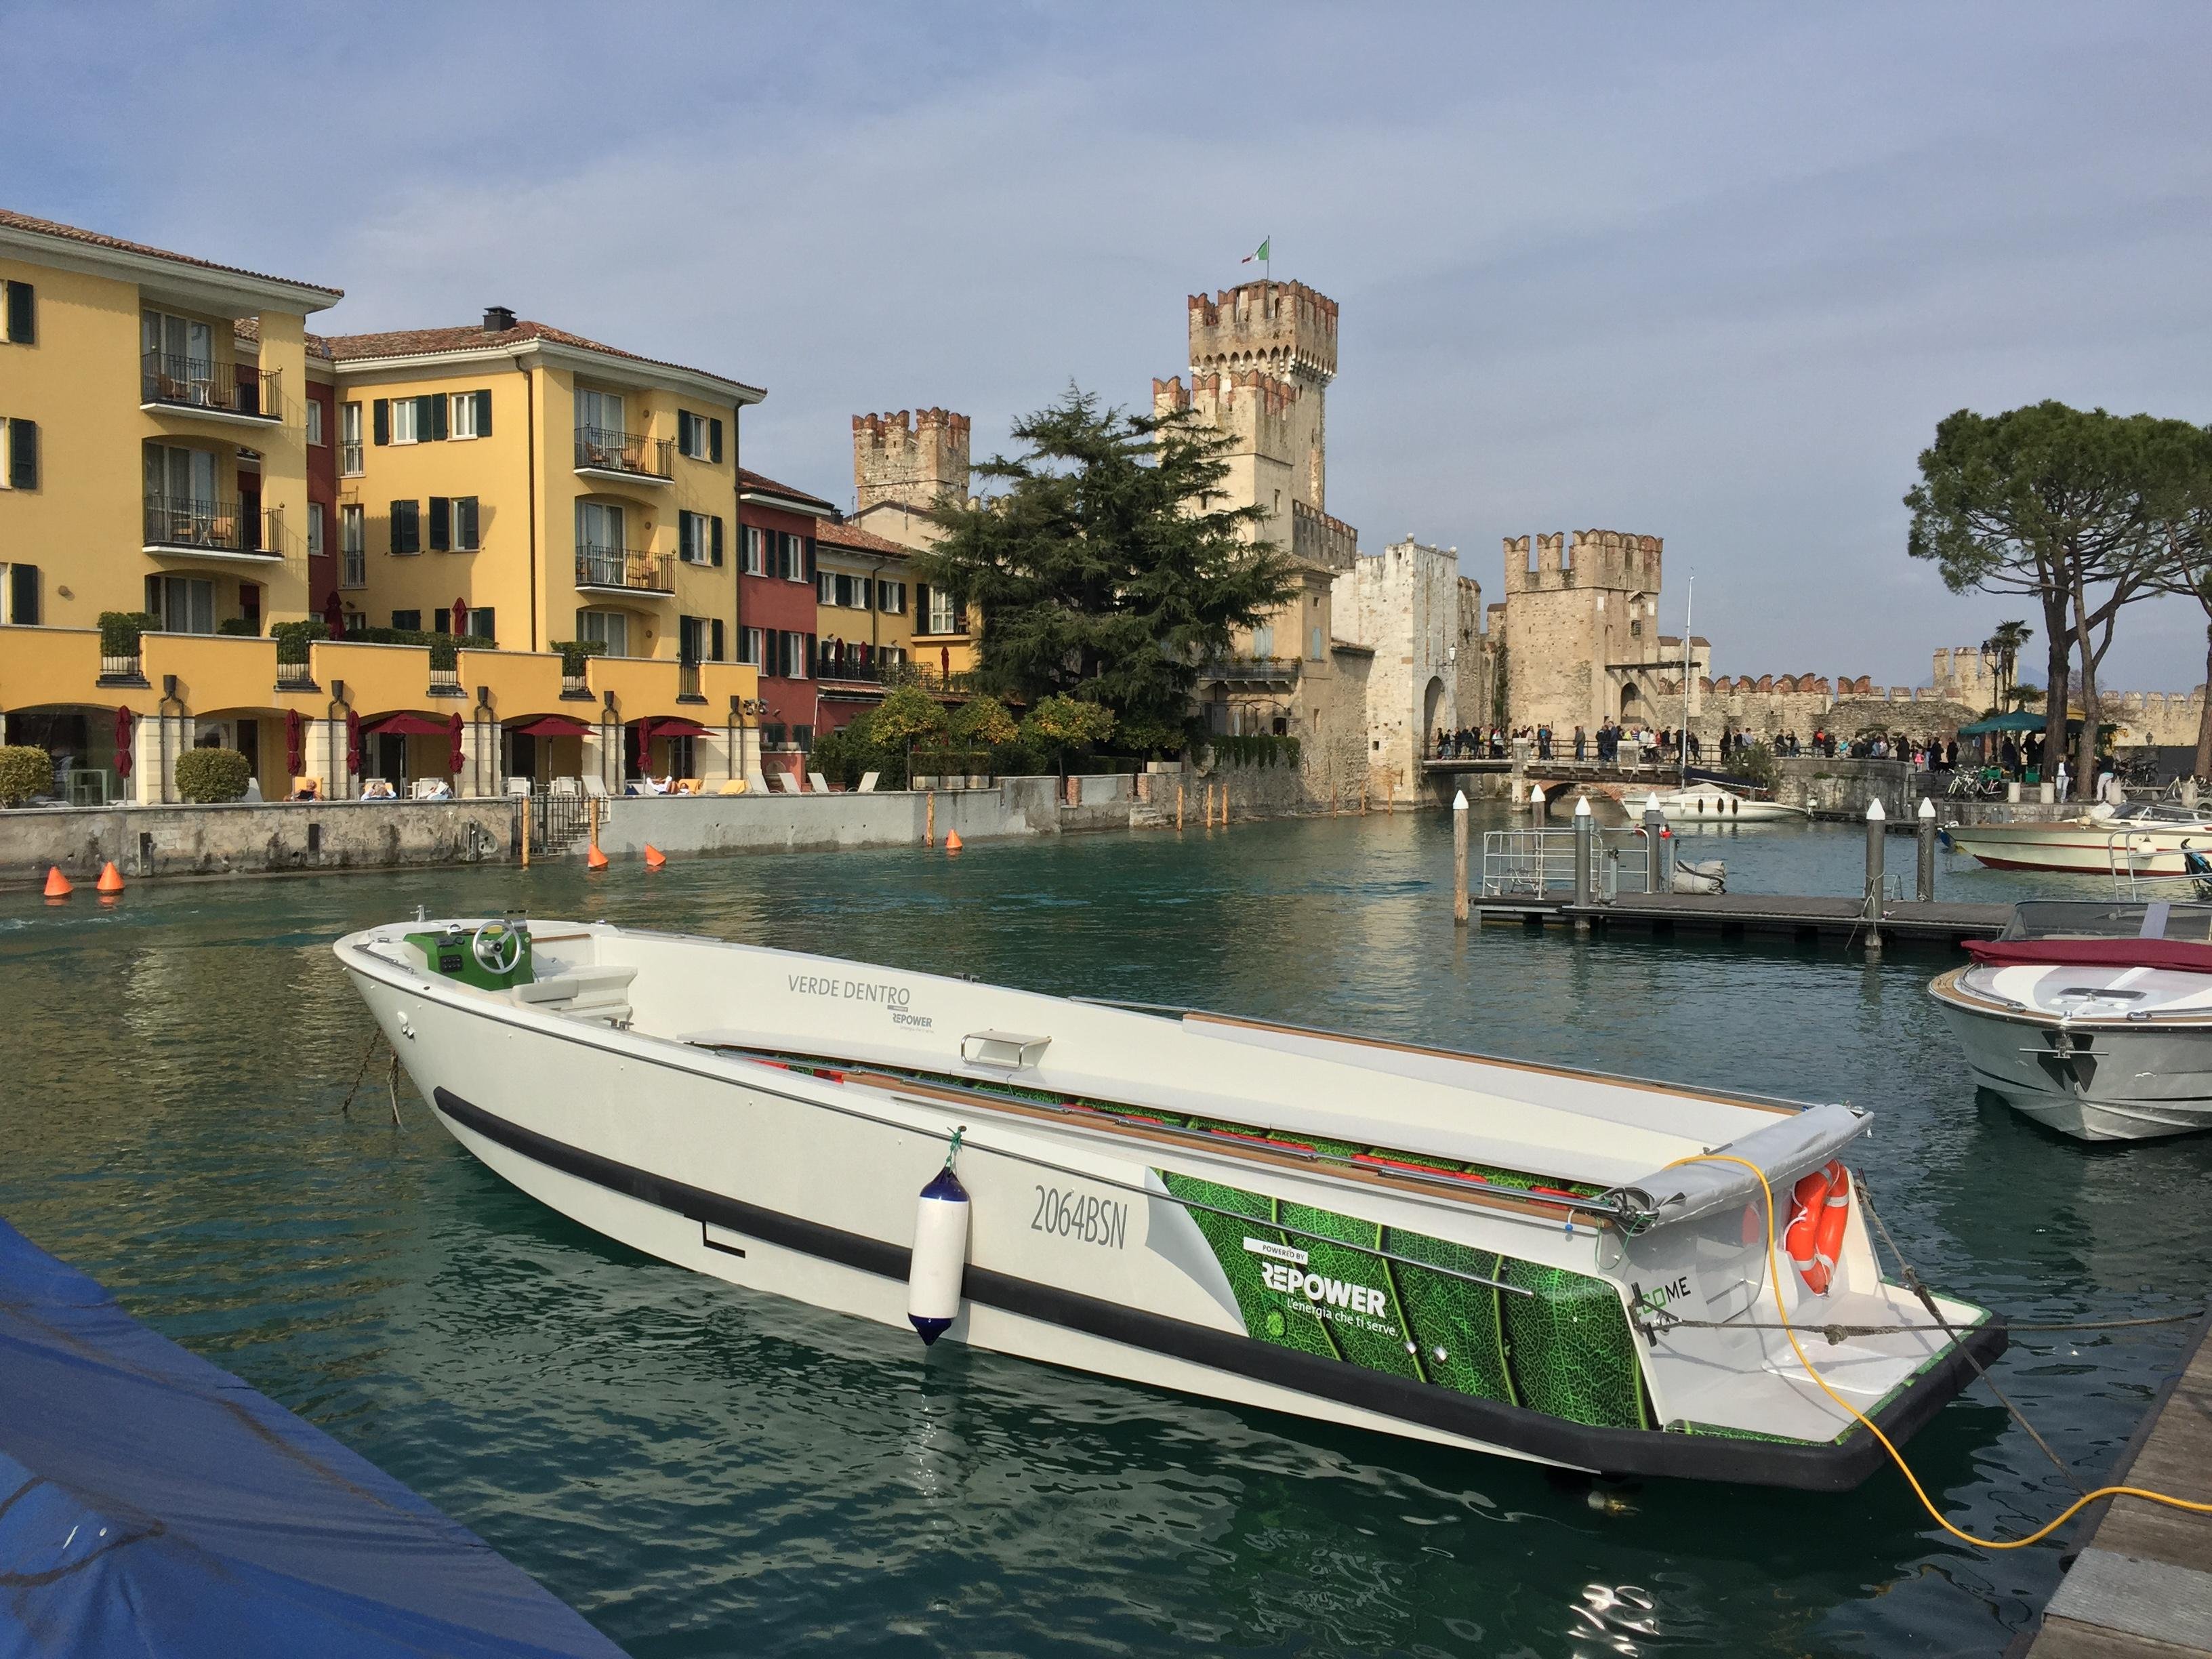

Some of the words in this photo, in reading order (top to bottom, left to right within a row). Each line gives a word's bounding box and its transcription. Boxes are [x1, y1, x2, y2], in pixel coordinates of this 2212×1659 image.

[787, 975, 839, 997] VERDE
[844, 981, 911, 1006] DENTRO
[892, 1012, 933, 1028] REPOWER
[1031, 1185, 1128, 1250] 2064BSN
[1263, 1244, 1295, 1258] POWERED
[1296, 1252, 1305, 1261] BY
[1261, 1261, 1387, 1318] REPOWER
[1637, 1276, 1692, 1317] COME
[1287, 1297, 1333, 1319] L'energia
[1334, 1311, 1354, 1325] che
[1355, 1315, 1364, 1328] ti
[1366, 1321, 1399, 1337] serve.
